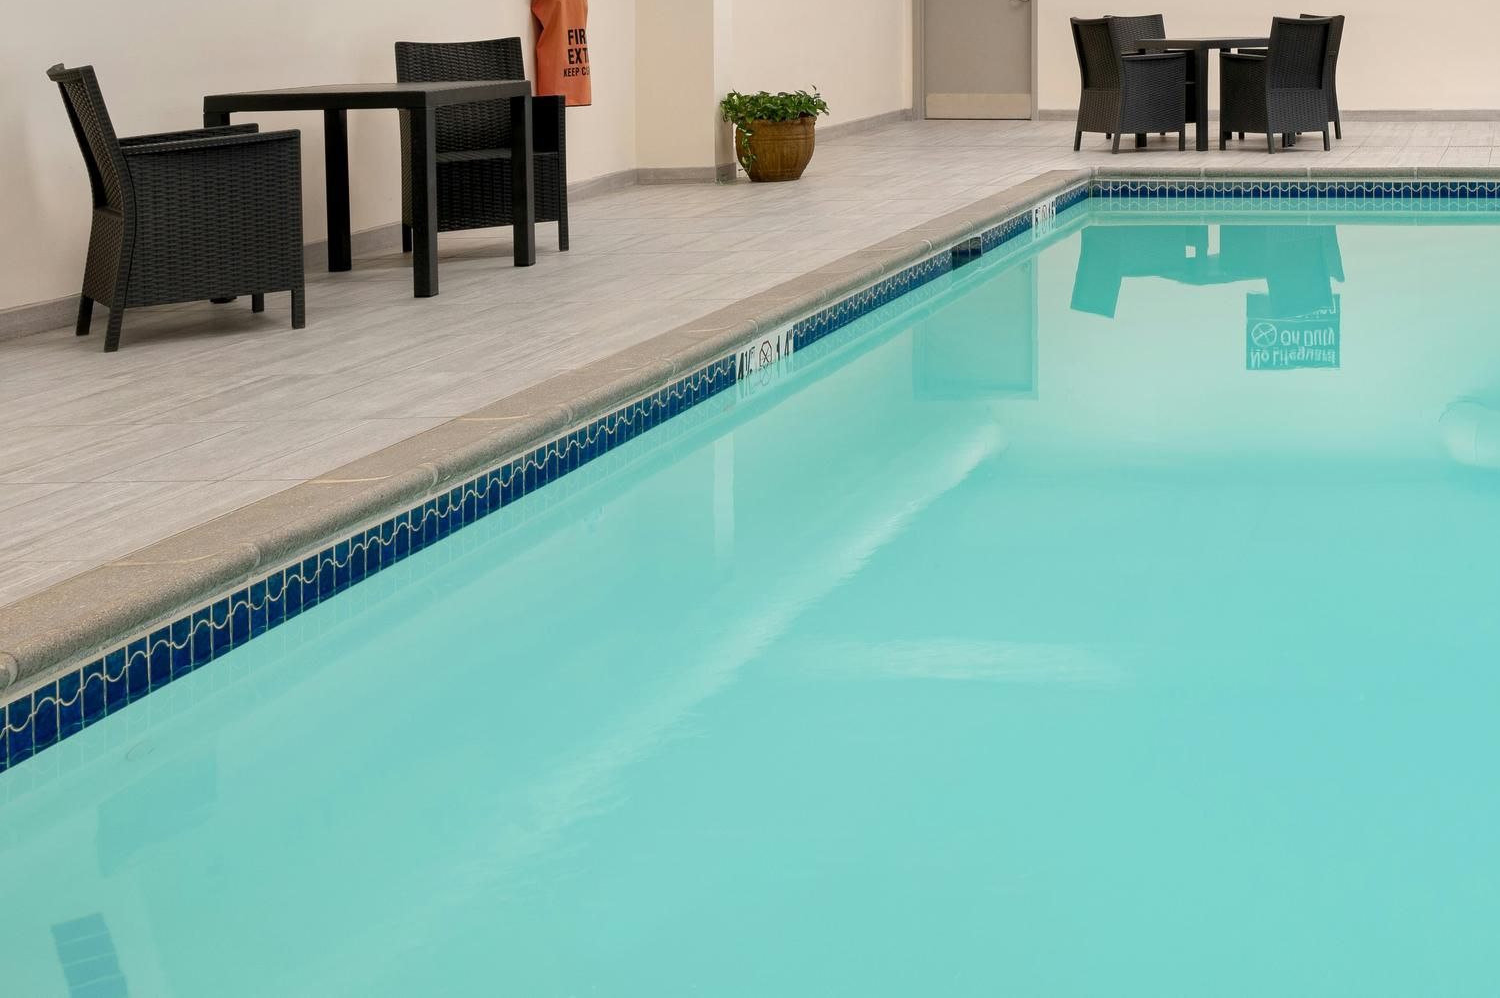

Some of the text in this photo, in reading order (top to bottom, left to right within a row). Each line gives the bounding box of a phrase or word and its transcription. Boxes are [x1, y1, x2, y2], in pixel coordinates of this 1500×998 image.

[568, 29, 587, 45] FIR
[568, 48, 589, 64] EXT
[563, 67, 579, 77] KEEP
